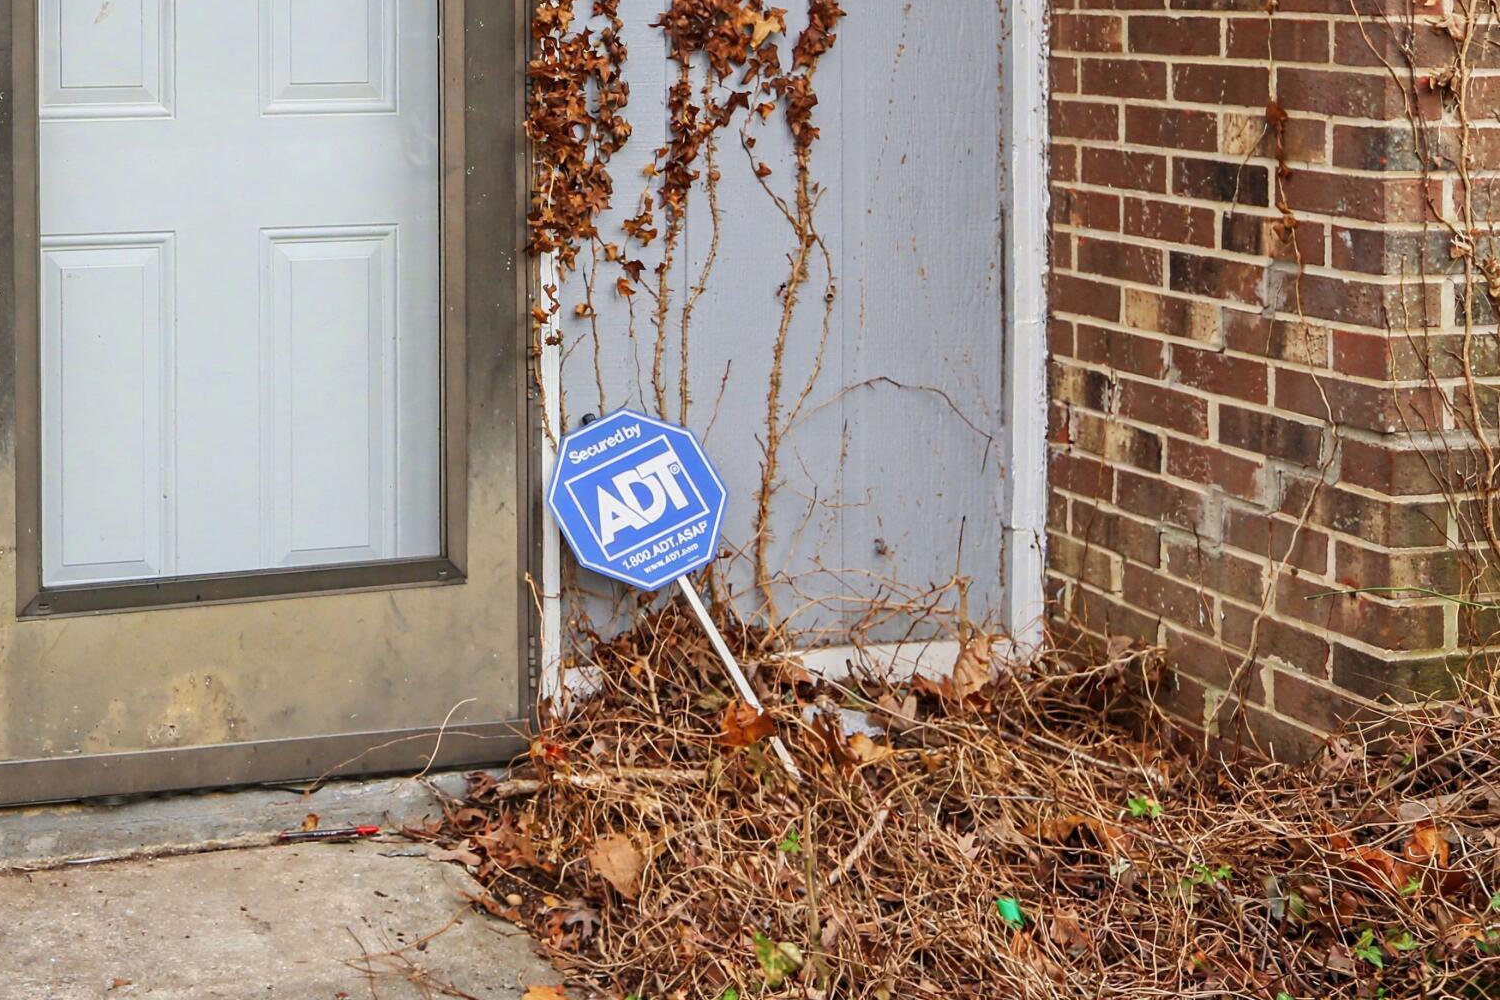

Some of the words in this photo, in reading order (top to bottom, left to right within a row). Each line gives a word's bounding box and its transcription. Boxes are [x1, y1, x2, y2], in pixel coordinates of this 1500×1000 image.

[568, 428, 625, 465] Secured
[622, 423, 641, 439] by
[597, 450, 690, 547] ADT
